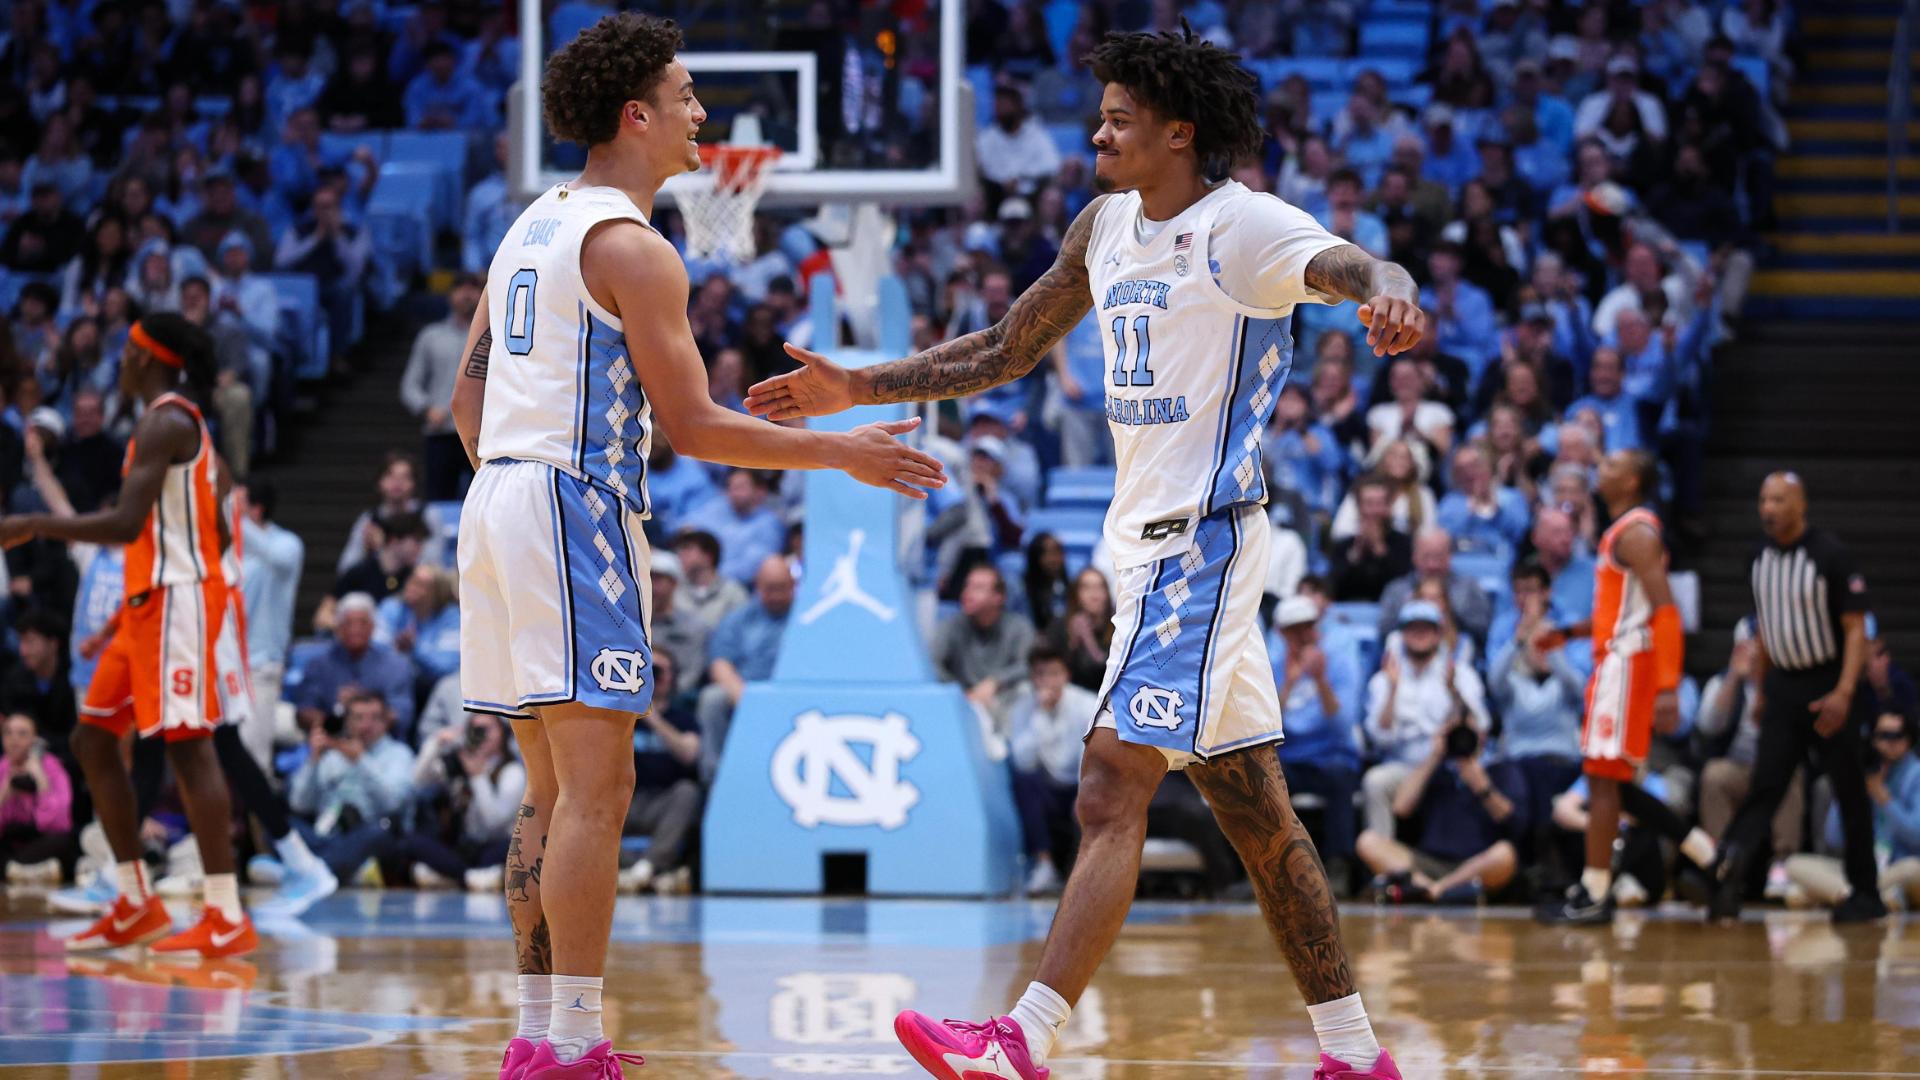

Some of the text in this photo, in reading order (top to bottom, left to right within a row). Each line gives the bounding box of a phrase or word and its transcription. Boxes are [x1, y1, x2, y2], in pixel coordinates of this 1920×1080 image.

[1103, 279, 1170, 310] NORTH
[505, 268, 538, 356] 0
[1112, 315, 1154, 386] 11
[1104, 394, 1190, 425] AROLINA
[172, 669, 194, 697] S
